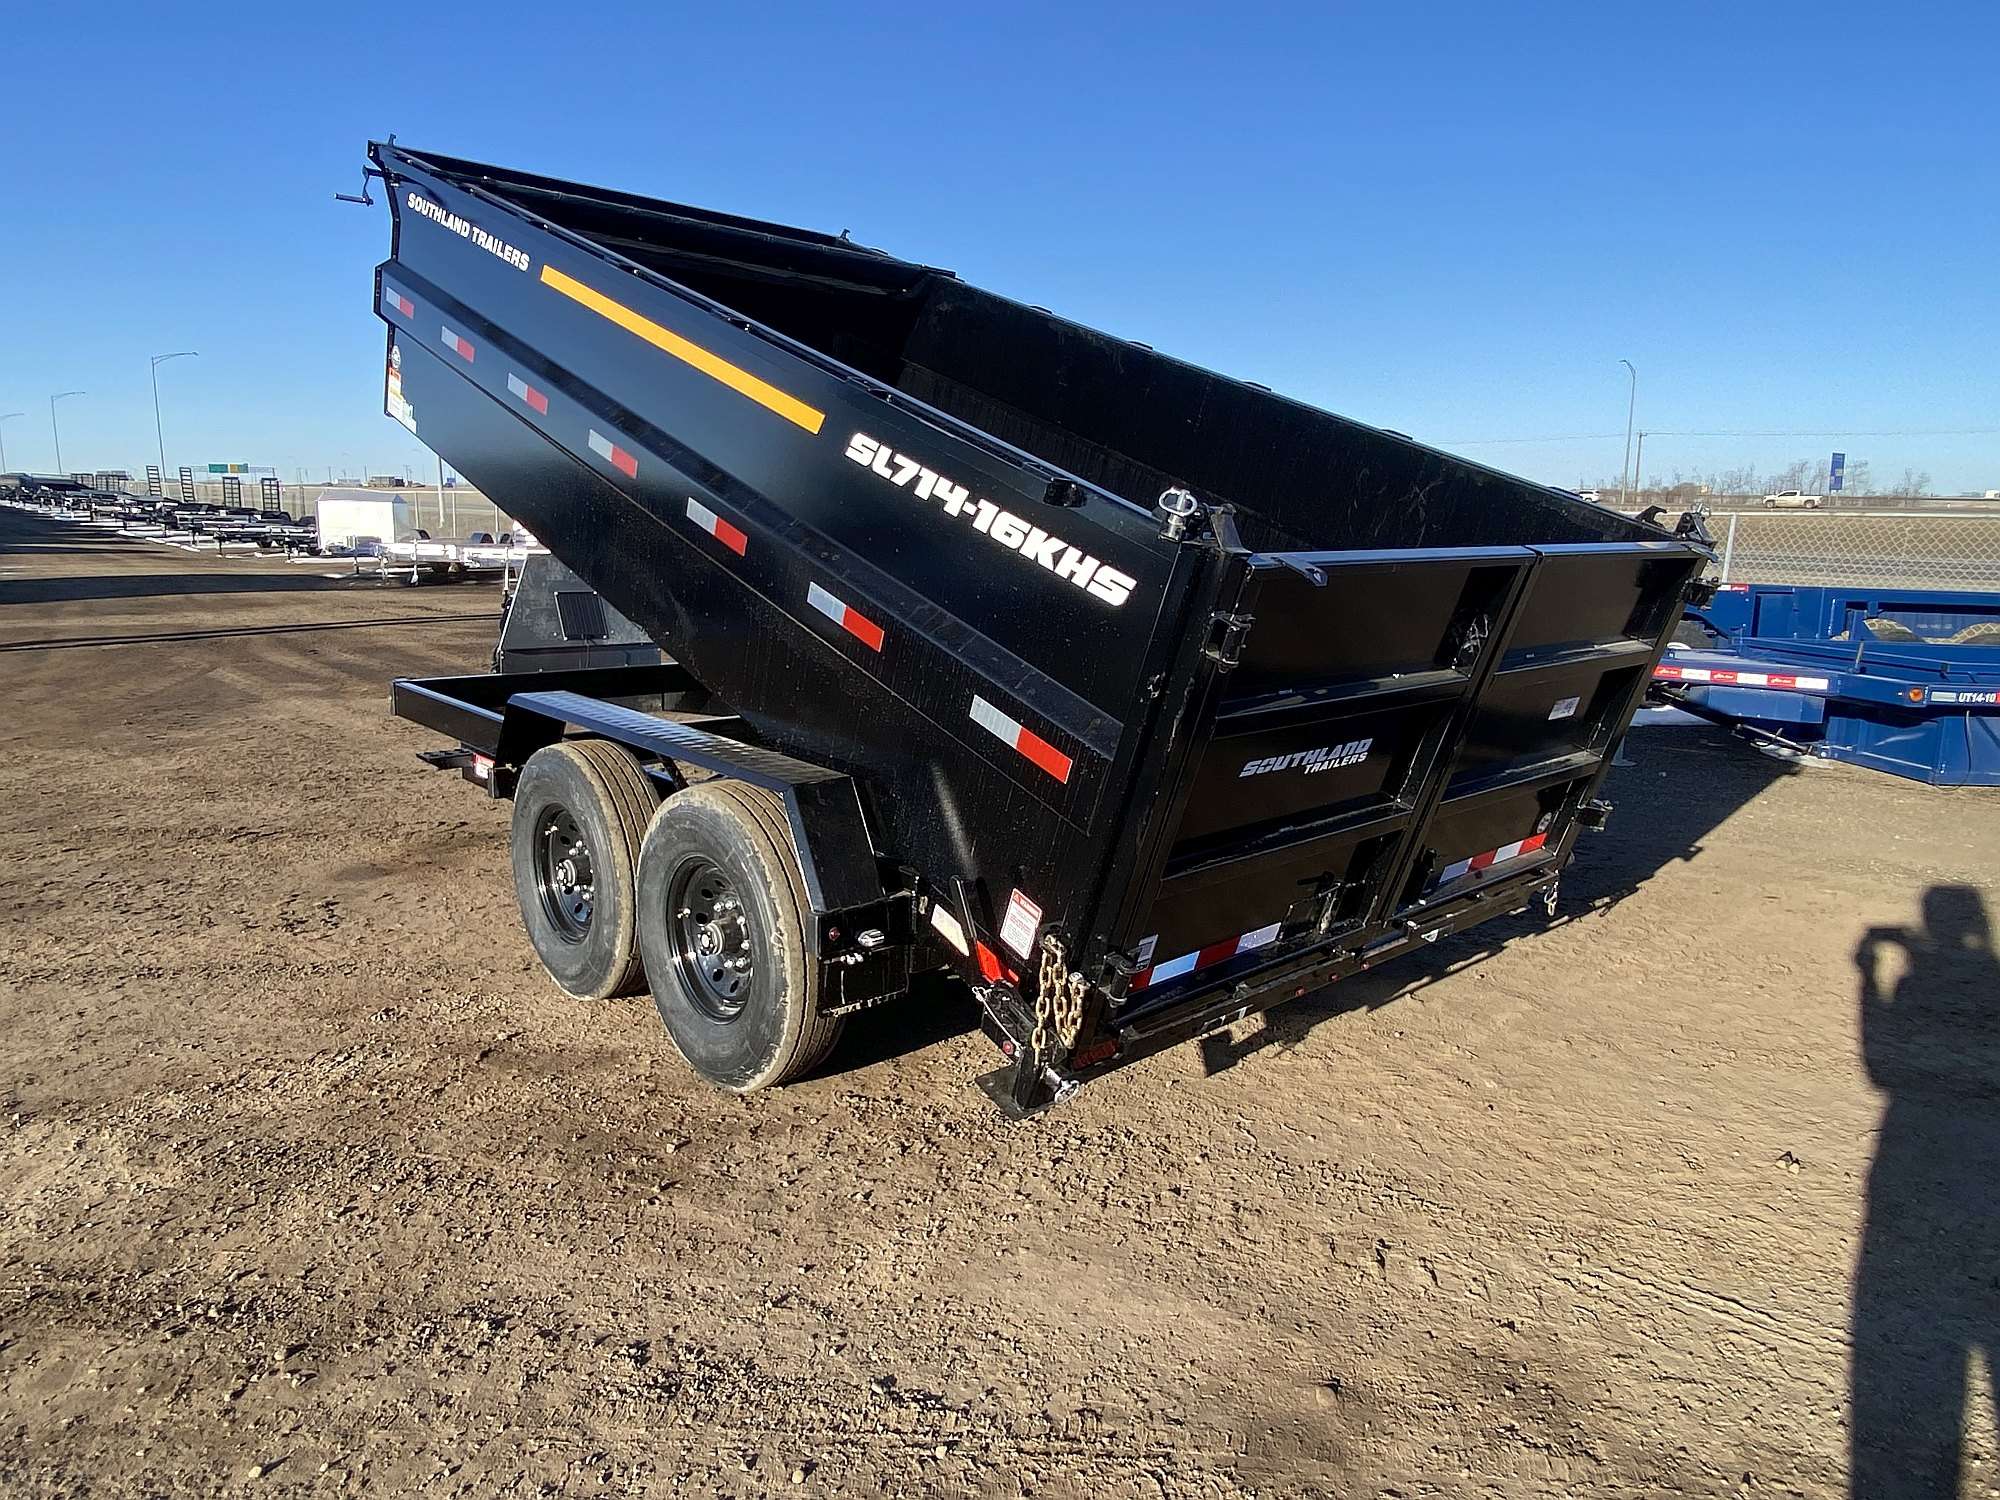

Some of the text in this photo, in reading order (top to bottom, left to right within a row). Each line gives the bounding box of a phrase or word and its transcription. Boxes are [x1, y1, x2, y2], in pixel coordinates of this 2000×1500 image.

[408, 192, 530, 272] SOUTHLAND TRAILERS
[844, 432, 1138, 607] SL714-16KHS
[1958, 692, 1996, 703] UT14-10
[1238, 738, 1373, 778] SOUTHLAND
[1304, 752, 1368, 774] TRAILERS
